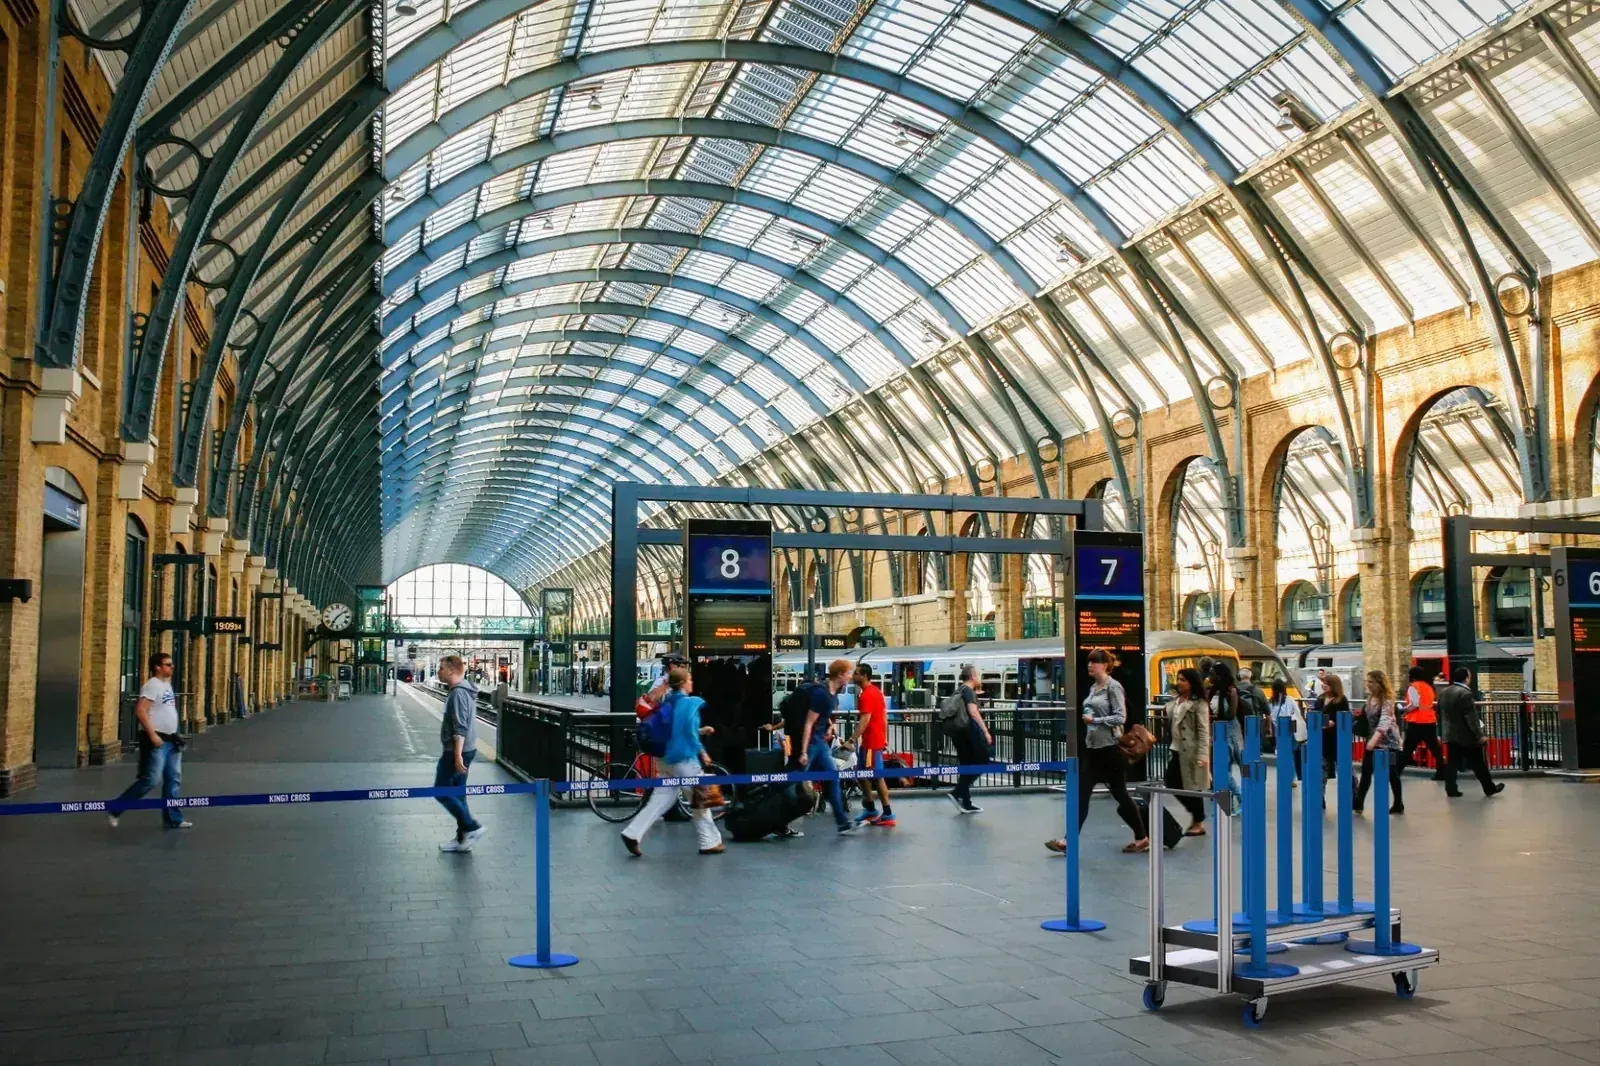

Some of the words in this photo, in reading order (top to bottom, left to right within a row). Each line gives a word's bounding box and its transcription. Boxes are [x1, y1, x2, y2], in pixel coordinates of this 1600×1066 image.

[720, 549, 740, 579] 8
[1101, 559, 1118, 586] 7
[1554, 569, 1565, 586] 6
[941, 766, 958, 774] CROSS
[1023, 763, 1040, 771] CROSS
[770, 773, 788, 781] CROSS
[856, 770, 874, 778] CROSS
[590, 781, 609, 789] CROSS
[681, 777, 700, 785] CROSS
[485, 785, 505, 793] CROSS
[389, 789, 409, 798] CROSS
[188, 798, 209, 806] CROSS
[290, 794, 311, 802] CROSS
[84, 802, 105, 810] CROSS
